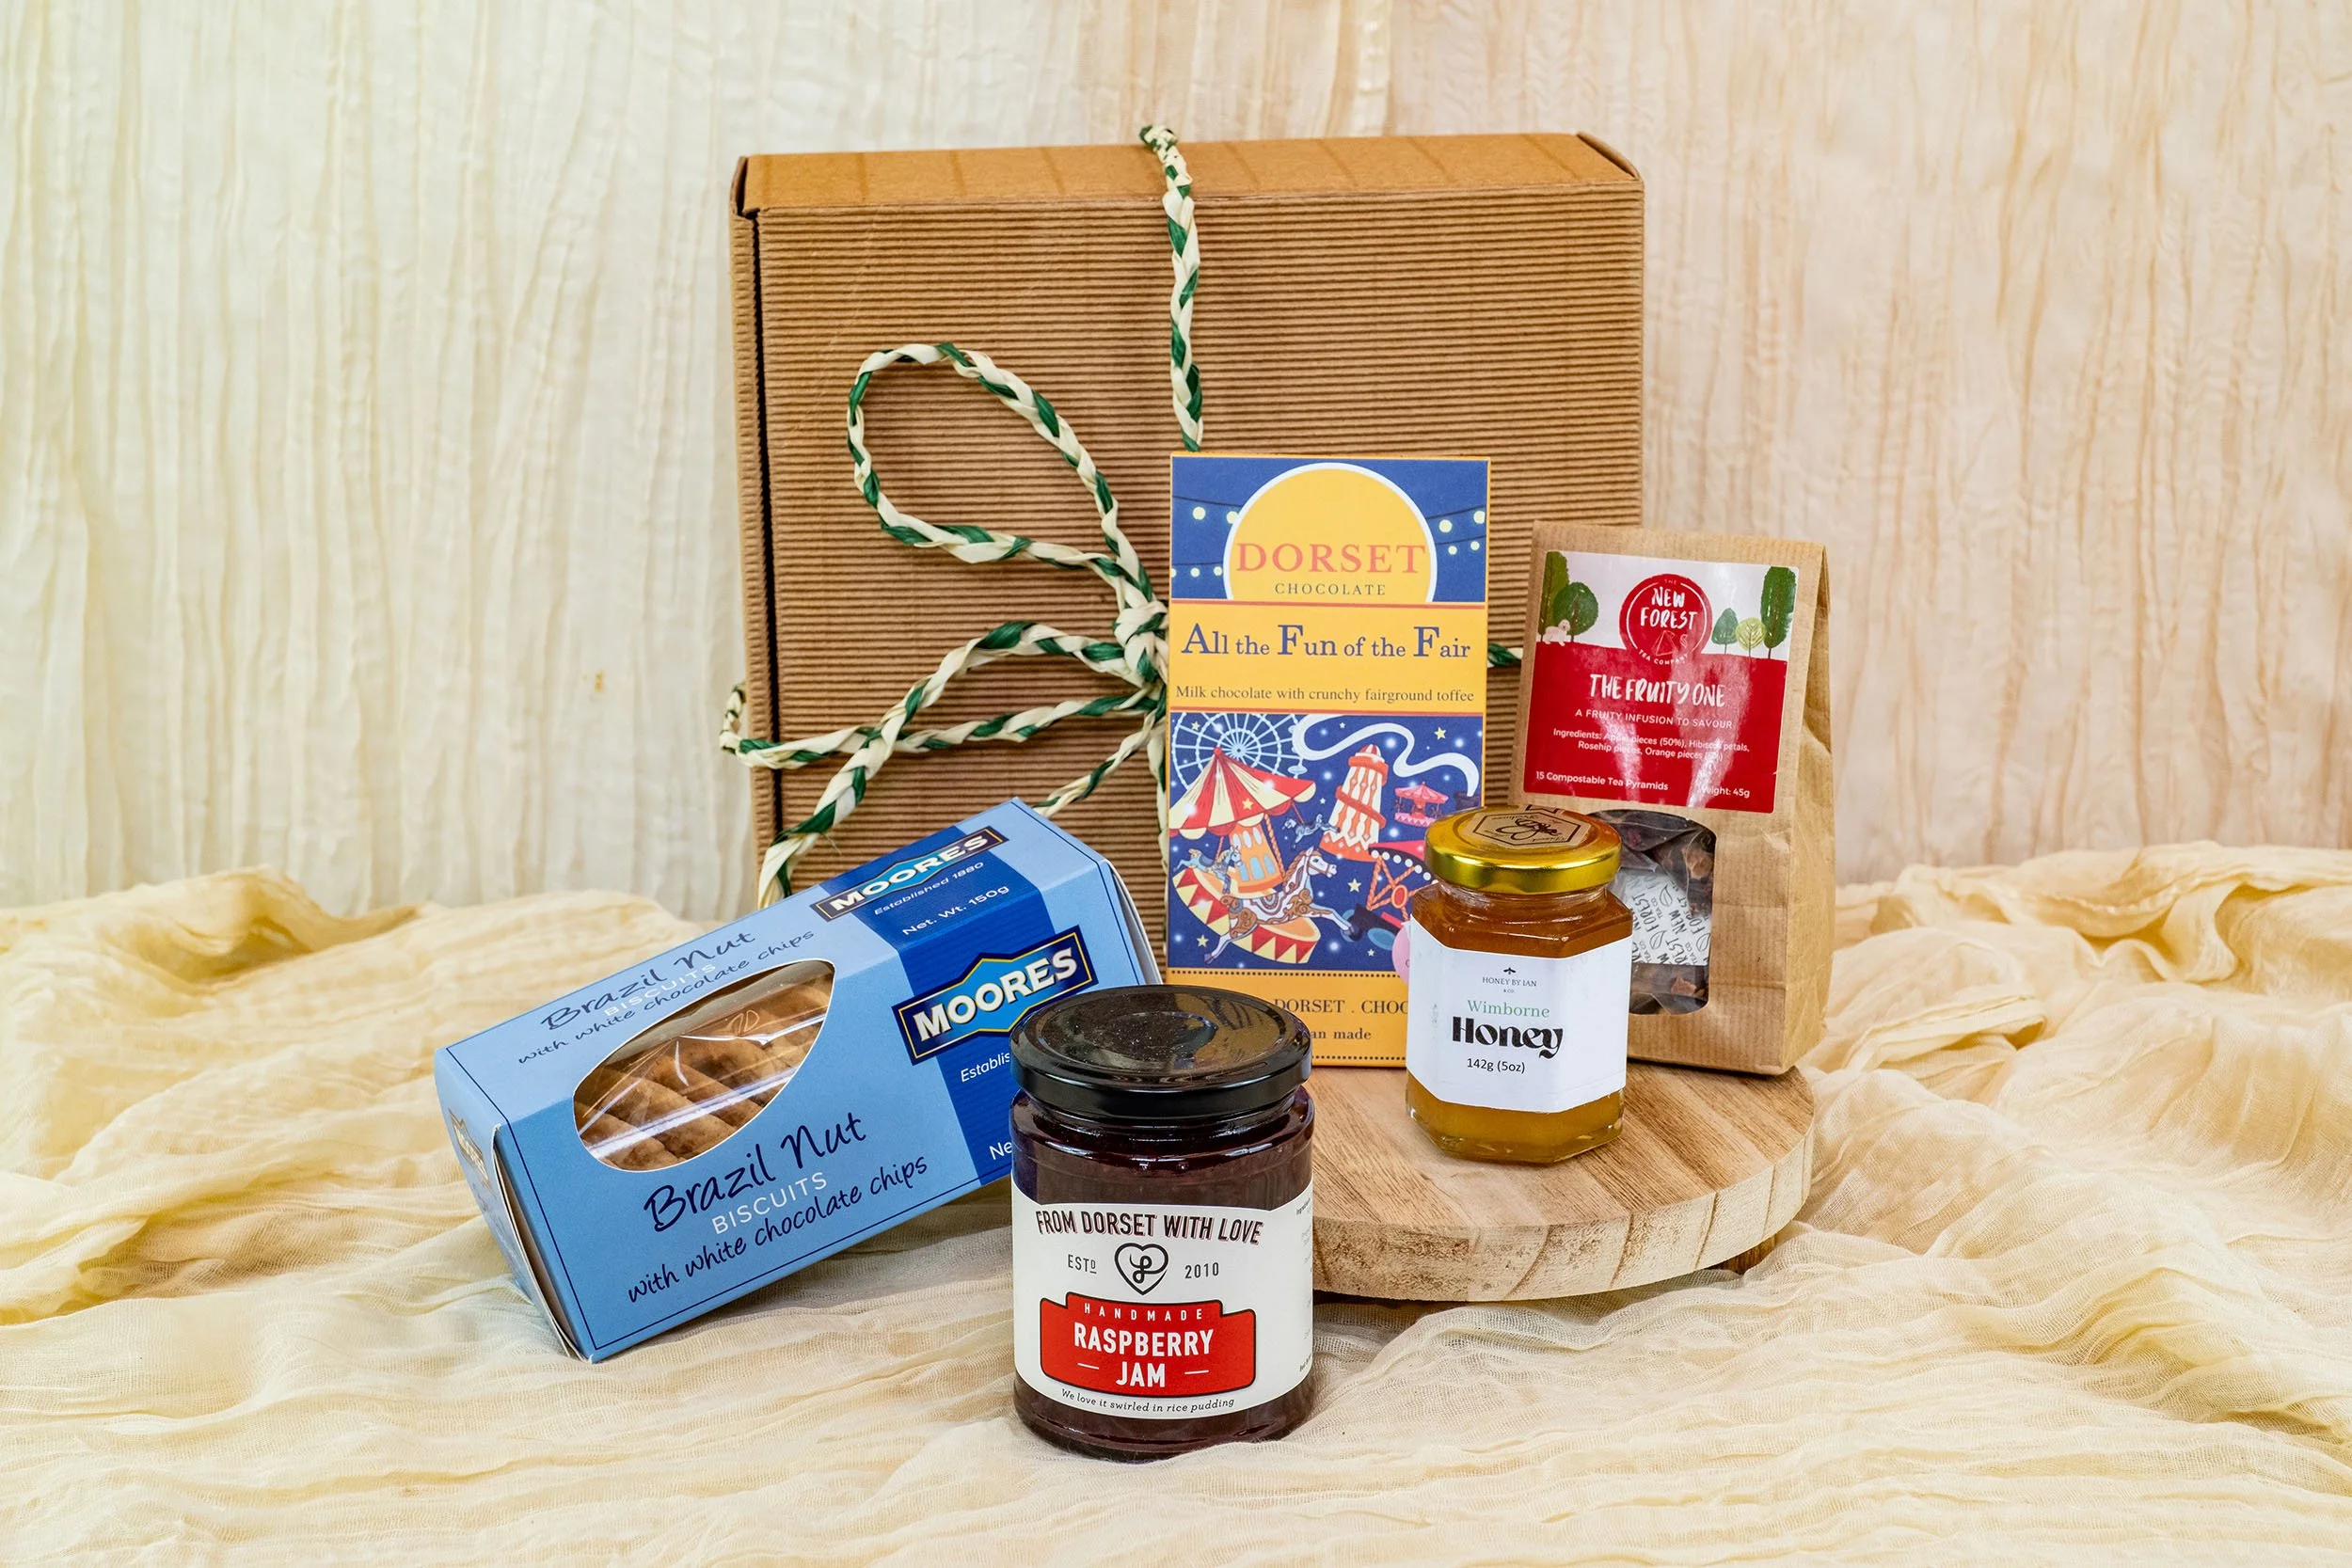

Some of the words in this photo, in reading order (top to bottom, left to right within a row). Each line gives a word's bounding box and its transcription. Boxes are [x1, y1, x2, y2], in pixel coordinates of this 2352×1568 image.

[1236, 543, 1426, 574] DORSET
[1275, 583, 1386, 595] CHOCOLATE
[1651, 586, 1685, 608] NEW
[1640, 607, 1698, 630] FOREST
[1181, 623, 1229, 655] All
[1235, 636, 1270, 656] the
[1278, 625, 1337, 657] Fun
[1343, 637, 1366, 657] of
[1372, 637, 1406, 657] the
[1413, 626, 1471, 658] Fair
[1638, 649, 1651, 661] TEA
[1176, 685, 1207, 699] Milk
[1211, 686, 1272, 700] chocolate
[1277, 687, 1305, 701] with
[1309, 688, 1360, 704] crunchy
[1365, 688, 1433, 704] fairground
[1437, 689, 1474, 703] toffee
[1590, 673, 1622, 699] THE
[1626, 678, 1690, 704] FRUITY
[1692, 684, 1725, 706] ONE
[1575, 708, 1582, 717] A
[1585, 709, 1623, 720] FRUITY
[1625, 713, 1674, 725] INFUSION
[1677, 717, 1690, 726] TO
[1693, 719, 1733, 729] SAVOUR
[1553, 728, 1601, 739] Ingredients:
[1578, 740, 1612, 752] Rosehip
[1645, 748, 1676, 759] Orange
[1677, 750, 1702, 760] pieces
[1535, 771, 1545, 780] 15
[1547, 772, 1605, 785] Compostable
[1608, 778, 1624, 786] Tea
[1626, 780, 1669, 790] Pyramids
[1733, 788, 1750, 799] 45g
[833, 835, 989, 911] MOORES
[874, 878, 949, 915] Established
[951, 862, 985, 880] 1880
[902, 916, 937, 937] Net.
[938, 904, 967, 920] Wt.
[967, 885, 1010, 906] 150g
[541, 969, 668, 1030] Brazil
[674, 931, 755, 970] Nut
[604, 964, 717, 1017] BISCUITS
[1482, 977, 1510, 986] HONEY
[518, 1039, 569, 1064] with
[576, 1011, 635, 1040] white
[644, 959, 750, 1011] chocolate
[758, 930, 814, 960] chips
[912, 947, 1078, 1042] MOORES
[1274, 998, 1345, 1013] DORSET
[1467, 999, 1550, 1019] Wimborne
[1333, 1028, 1372, 1039] made
[1452, 1016, 1564, 1059] Honey
[1467, 1057, 1494, 1072] 142g
[1497, 1059, 1526, 1074] (5oz)
[644, 1143, 776, 1232] Brazil
[781, 1112, 866, 1169] Nut
[712, 1172, 827, 1234] BISCUITS
[628, 1264, 679, 1303] with
[685, 1236, 747, 1277] white
[755, 1184, 863, 1246] chocolate
[869, 1156, 928, 1189] chips
[1035, 1210, 1077, 1235] FROM
[1081, 1211, 1157, 1237] DORSET
[1164, 1214, 1216, 1240] WITH
[1218, 1217, 1263, 1244] LOVE
[1184, 1261, 1219, 1278] 2010
[1084, 1303, 1202, 1322] HANDMADE
[1073, 1322, 1214, 1357] RASPBERRY
[1116, 1361, 1166, 1387] JAM
[1061, 1388, 1074, 1401] We
[1077, 1393, 1096, 1406] love
[1099, 1397, 1107, 1408] it
[1110, 1401, 1150, 1412] swirled
[1152, 1402, 1163, 1412] in
[1167, 1402, 1188, 1412] rice
[1191, 1398, 1234, 1414] pudding
